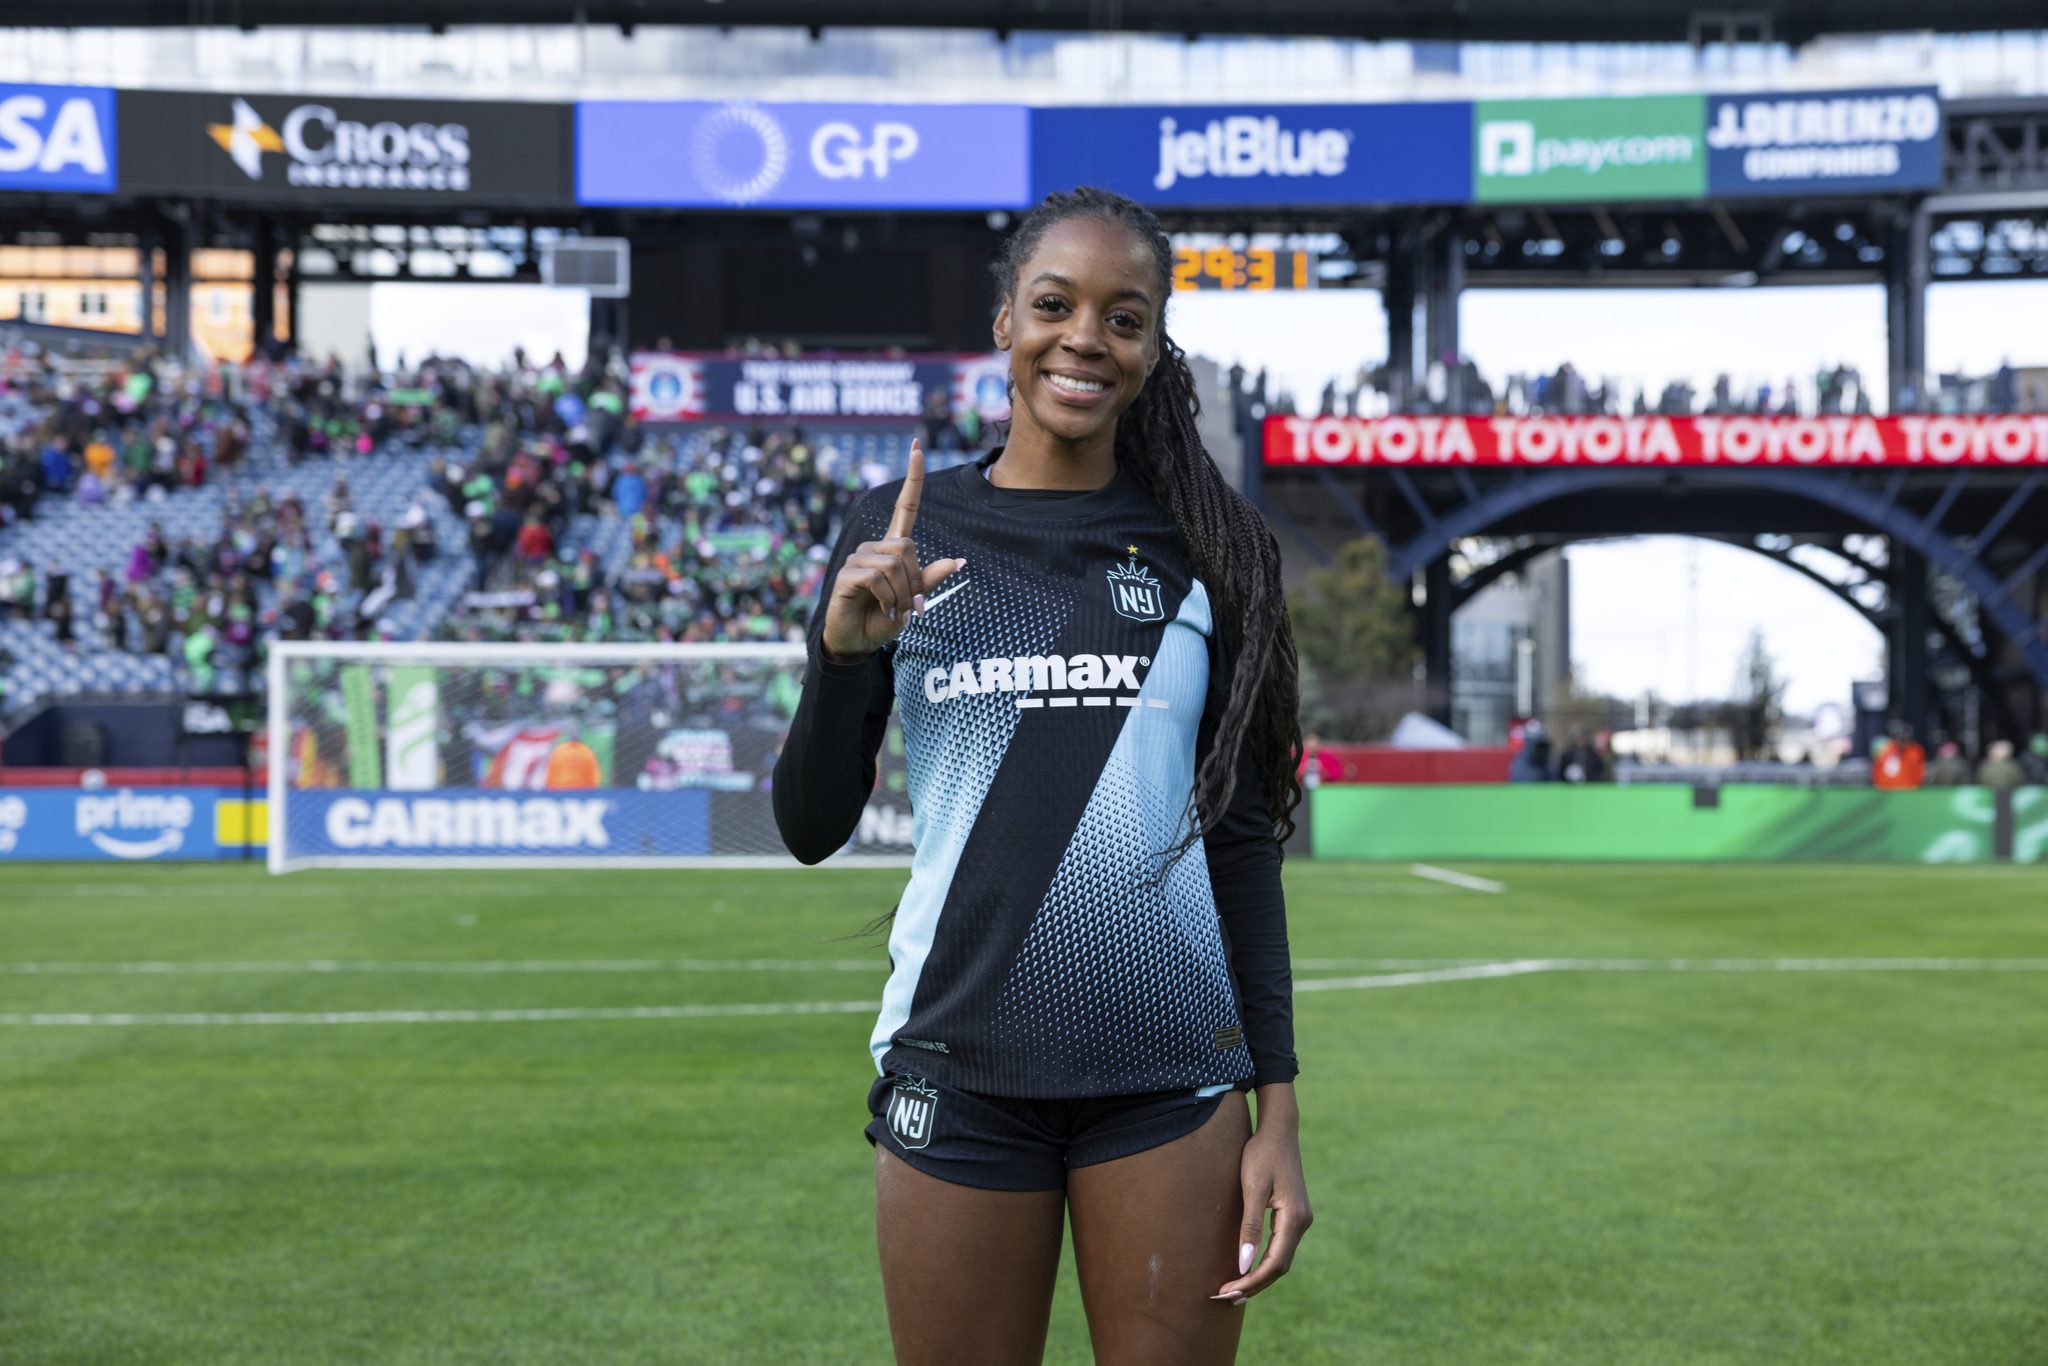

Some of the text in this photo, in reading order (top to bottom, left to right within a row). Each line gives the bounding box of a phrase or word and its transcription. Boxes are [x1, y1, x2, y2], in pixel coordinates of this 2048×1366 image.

[1153, 115, 1352, 190] jetBlue
[1536, 133, 1695, 174] paycom
[1743, 144, 1900, 181] COMPANIES
[840, 382, 924, 416] FORCE
[1284, 416, 1477, 463] TOYOTA
[1489, 416, 1682, 463] TOYOTA
[1693, 416, 1887, 463] TOYOTA
[1118, 583, 1156, 615] NY
[75, 788, 194, 837] prime
[893, 1096, 929, 1139] NY
